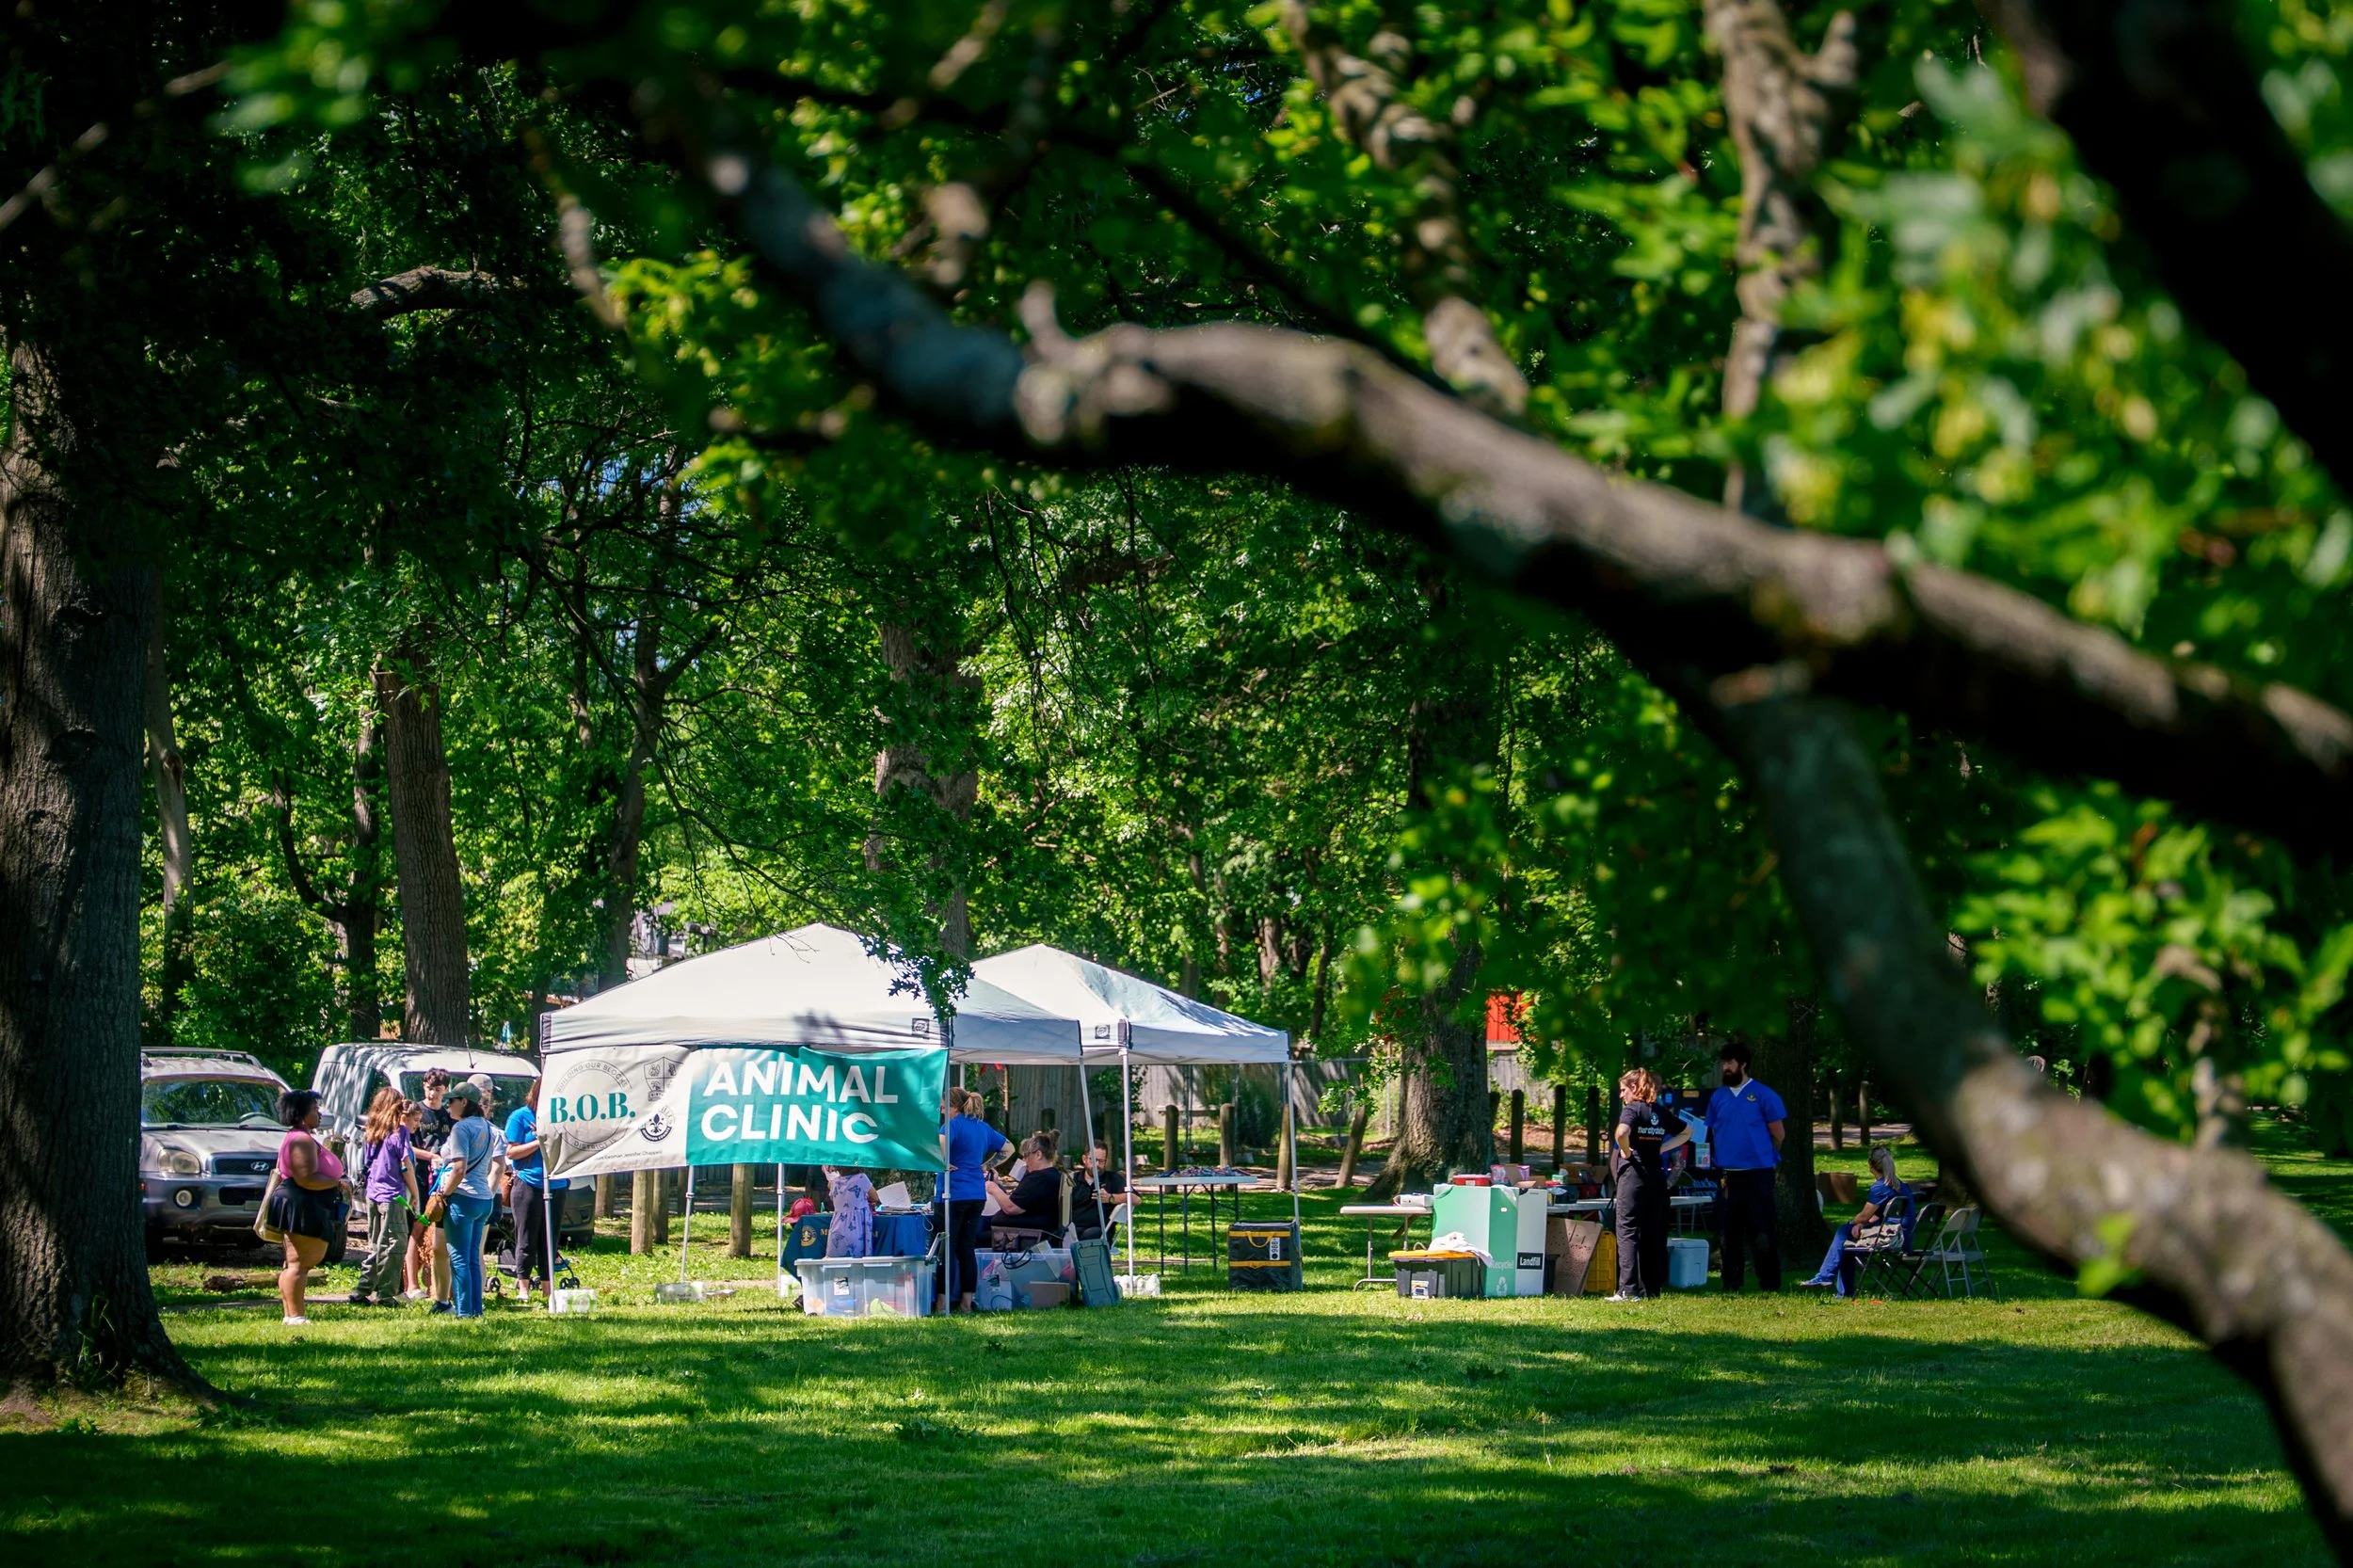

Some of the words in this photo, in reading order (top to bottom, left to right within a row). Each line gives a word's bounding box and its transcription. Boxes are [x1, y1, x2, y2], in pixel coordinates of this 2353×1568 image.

[557, 1064, 583, 1092] BUILDING
[703, 1061, 898, 1103] ANIMAL
[550, 1092, 636, 1124] B.O.B.
[701, 1104, 879, 1144] CLINIC
[1519, 1256, 1541, 1266] Landfill
